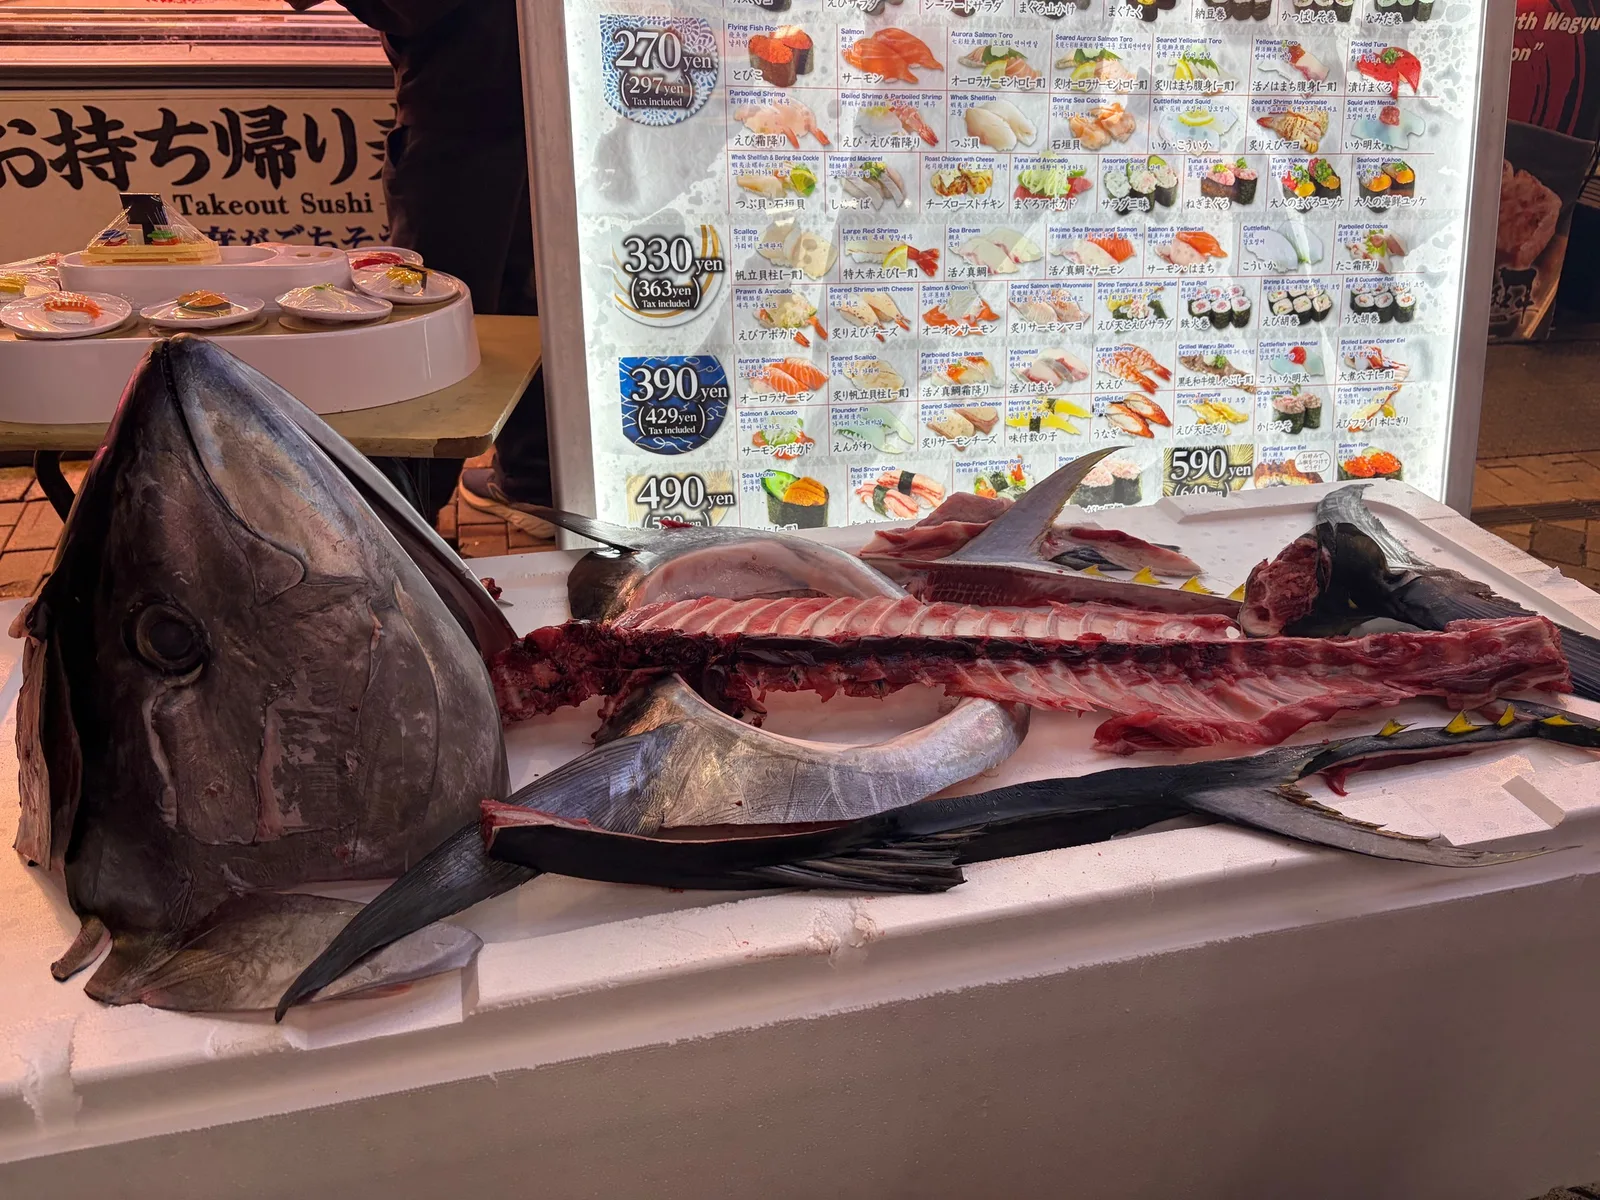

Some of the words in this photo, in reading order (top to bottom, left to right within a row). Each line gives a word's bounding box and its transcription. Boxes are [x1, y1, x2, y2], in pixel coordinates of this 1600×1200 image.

[1020, 2, 1076, 14] まぐろ山かけ
[1195, 8, 1226, 20] 納豆巻
[728, 23, 748, 32] Flying
[1514, 12, 1538, 30] th
[1543, 12, 1600, 34] Wagyu
[614, 30, 681, 69] 270
[683, 56, 712, 72] yen
[733, 69, 763, 81] とびこ
[842, 73, 883, 84] サーモン
[629, 76, 663, 94] 297
[664, 84, 684, 96] yen
[1348, 82, 1392, 92] 漬けまぐろ
[632, 97, 648, 106] Tax
[649, 98, 682, 106] included
[734, 135, 786, 147] えび霜降り
[951, 139, 980, 149] つぶ貝
[1051, 140, 1080, 150] 石垣貝
[172, 193, 288, 216] Takeout
[302, 191, 372, 214] Sushi
[926, 199, 1005, 209] チーズローストチキン
[1014, 199, 1076, 210] まぐろアボカド
[624, 237, 693, 273] 330
[695, 260, 723, 275] yen
[1243, 261, 1276, 270] こういか
[658, 300, 690, 308] included
[1181, 318, 1210, 329] 鉄火巻
[738, 329, 796, 341] えびアボカド
[922, 324, 998, 336] オニオンサーモン
[631, 367, 698, 401] 390
[700, 387, 728, 402] yen
[1096, 379, 1123, 389] 大えび
[740, 393, 814, 404] オーロラサーモン
[1257, 421, 1292, 432] かにみそ
[1009, 431, 1057, 443] 味付数の子
[1093, 428, 1119, 439] うなぎ
[742, 444, 812, 456] サーモンアボカド
[833, 441, 872, 452] えんがわ
[1170, 449, 1226, 481] 590
[1229, 465, 1251, 479] yen
[638, 475, 705, 509] 490
[707, 494, 734, 509] yen
